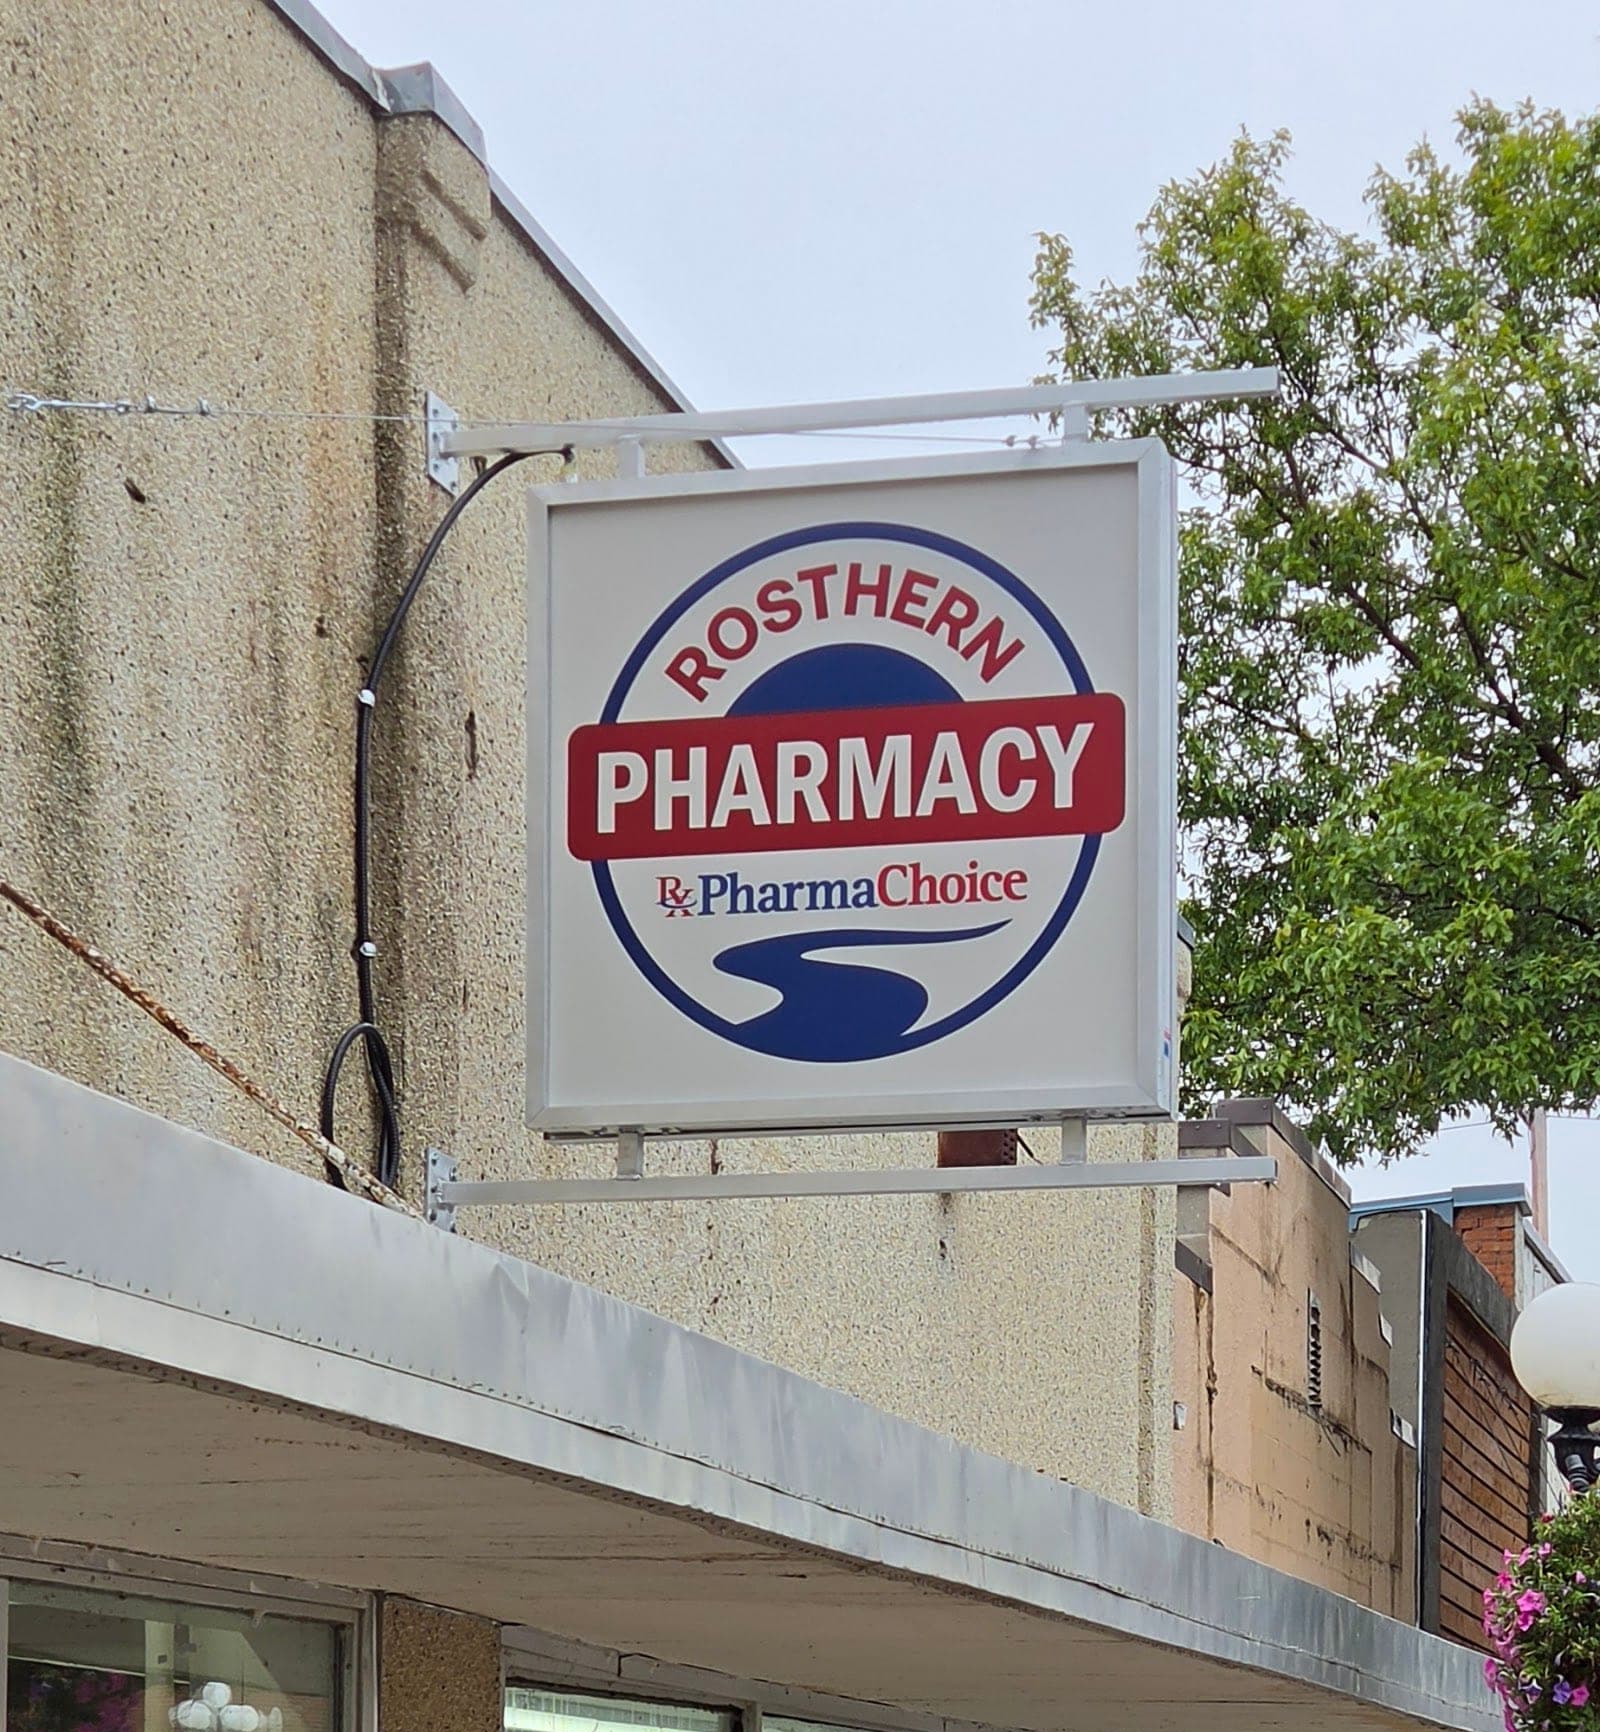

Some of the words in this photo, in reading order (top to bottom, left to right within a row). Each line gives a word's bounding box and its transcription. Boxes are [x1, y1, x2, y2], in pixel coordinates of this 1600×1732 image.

[665, 562, 1025, 703] ROSTHERN
[597, 722, 1095, 835] PHARMACY
[698, 860, 1029, 917] PharmaChoice
